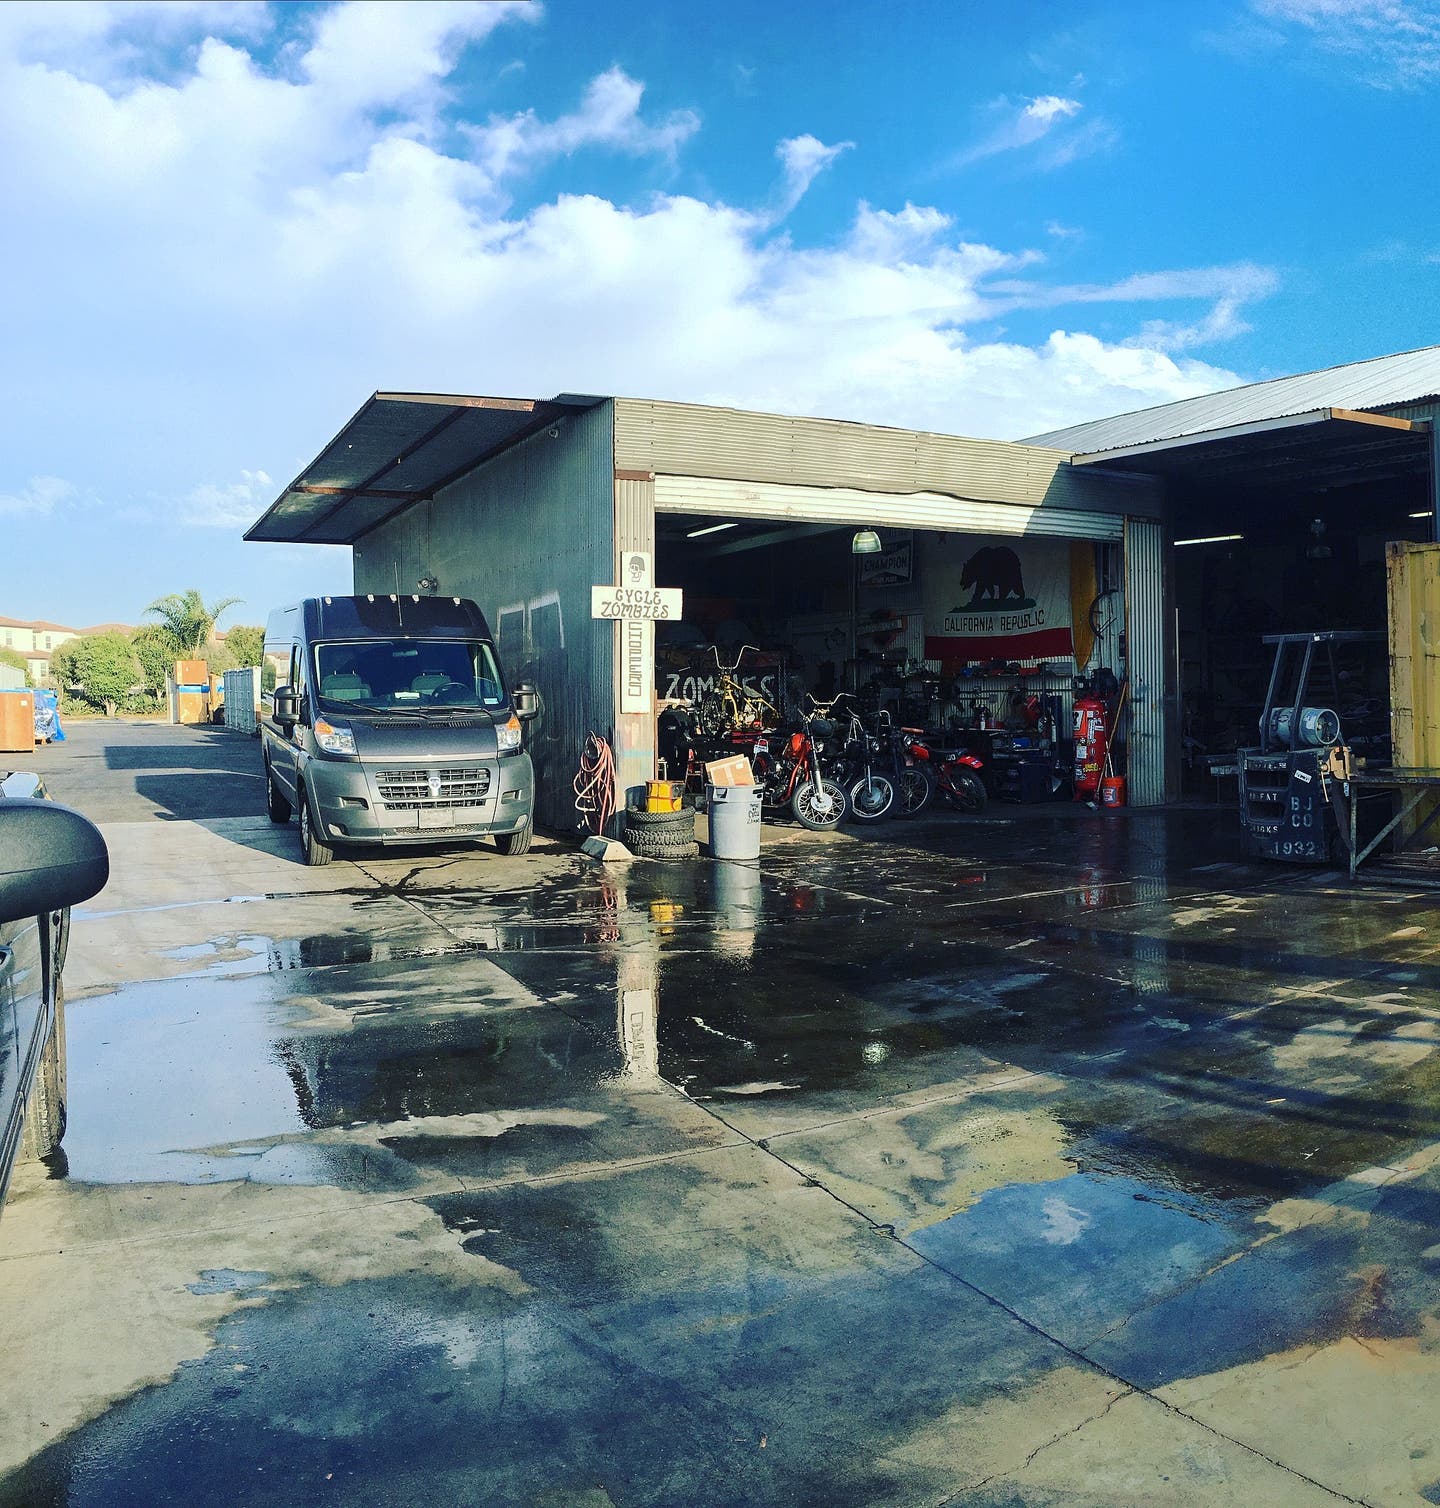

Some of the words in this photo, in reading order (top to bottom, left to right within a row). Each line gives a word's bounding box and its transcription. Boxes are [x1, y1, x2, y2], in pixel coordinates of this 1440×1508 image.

[864, 555, 907, 572] CHAMPION
[615, 589, 662, 605] CYCLE
[600, 601, 669, 619] ZOMBIES
[944, 616, 994, 632] CALIFORNIA
[1000, 609, 1045, 631] REPUBLIC
[1274, 841, 1316, 856] 1932
